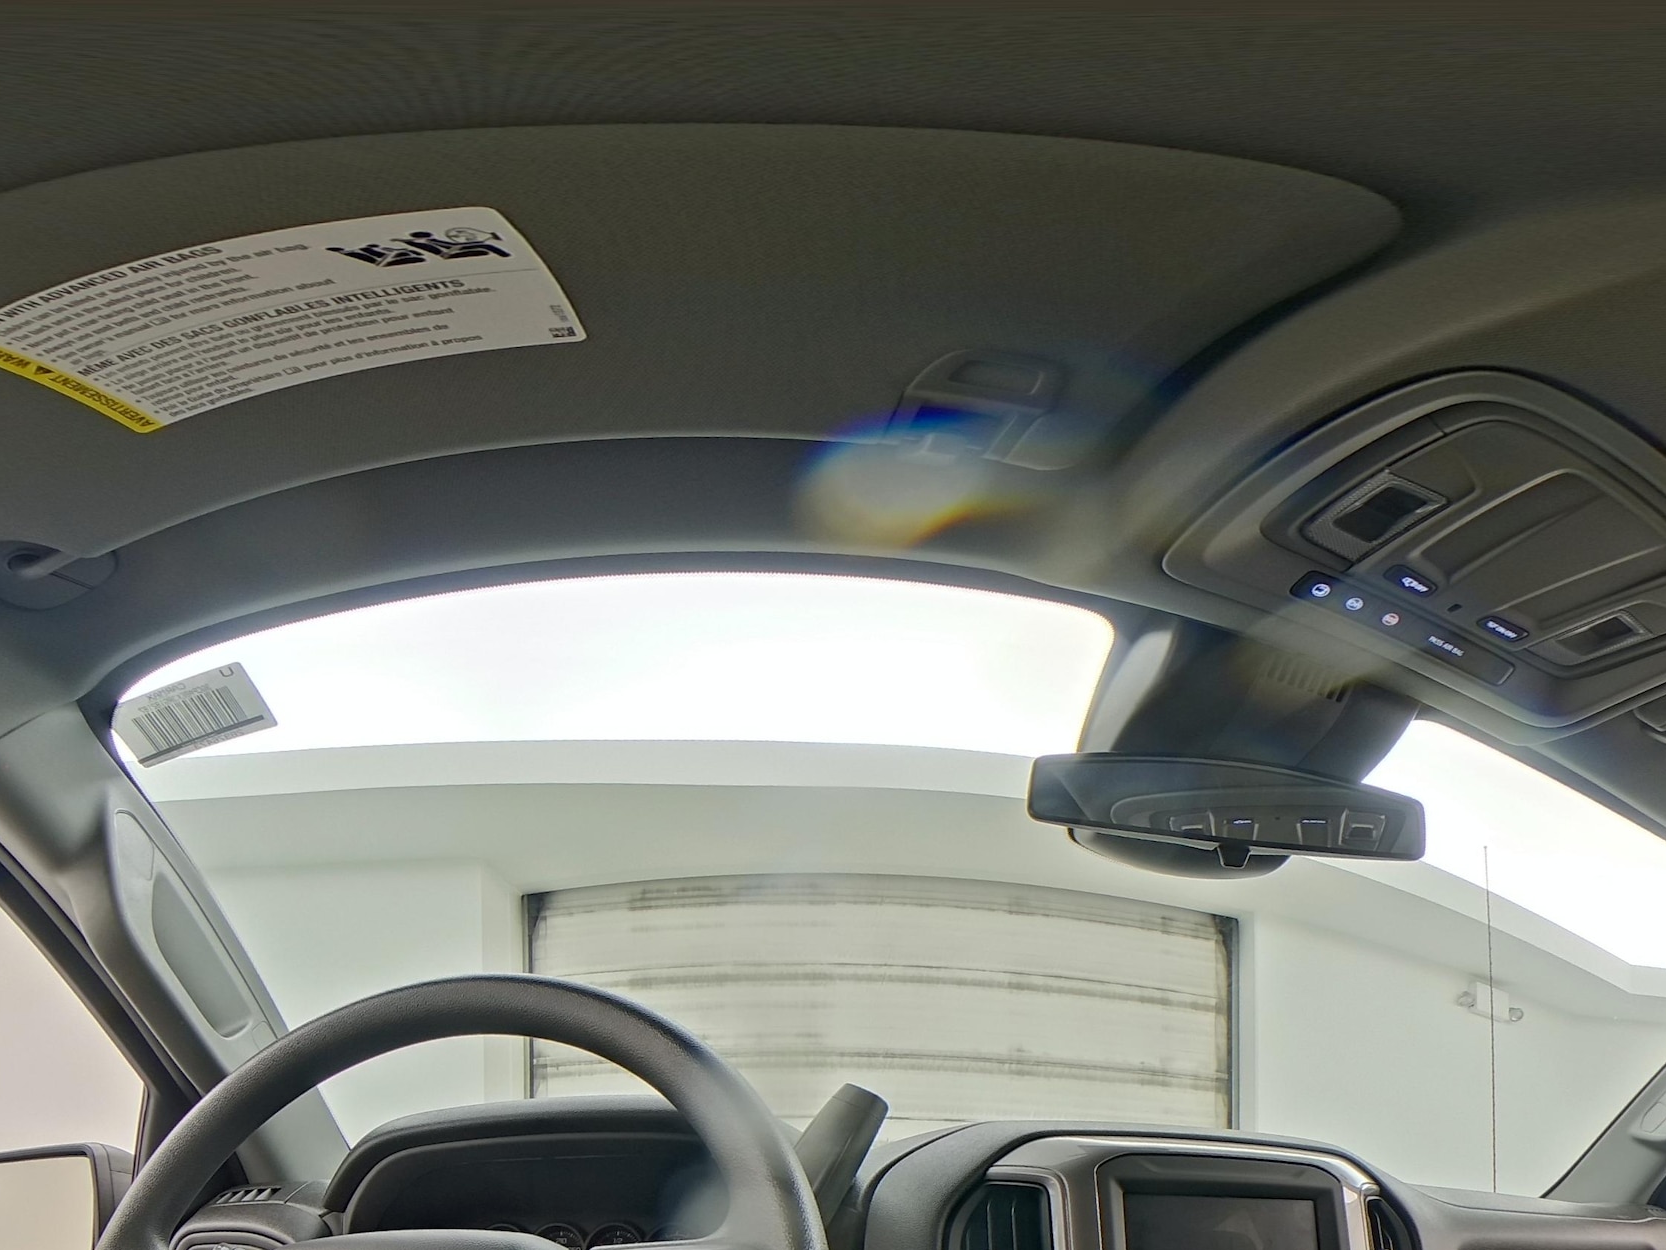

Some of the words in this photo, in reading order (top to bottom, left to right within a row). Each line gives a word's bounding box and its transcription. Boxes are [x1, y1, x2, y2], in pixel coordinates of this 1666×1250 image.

[0, 300, 43, 318] WITH
[38, 271, 128, 303] ADVANCED
[127, 261, 165, 273] AIR
[161, 246, 223, 264] BAGS
[116, 346, 153, 361] AVEC
[149, 336, 182, 349] DES
[180, 324, 223, 340] SACS
[221, 300, 331, 328] GONFLABLES
[330, 279, 465, 304] INTELLIGENTS
